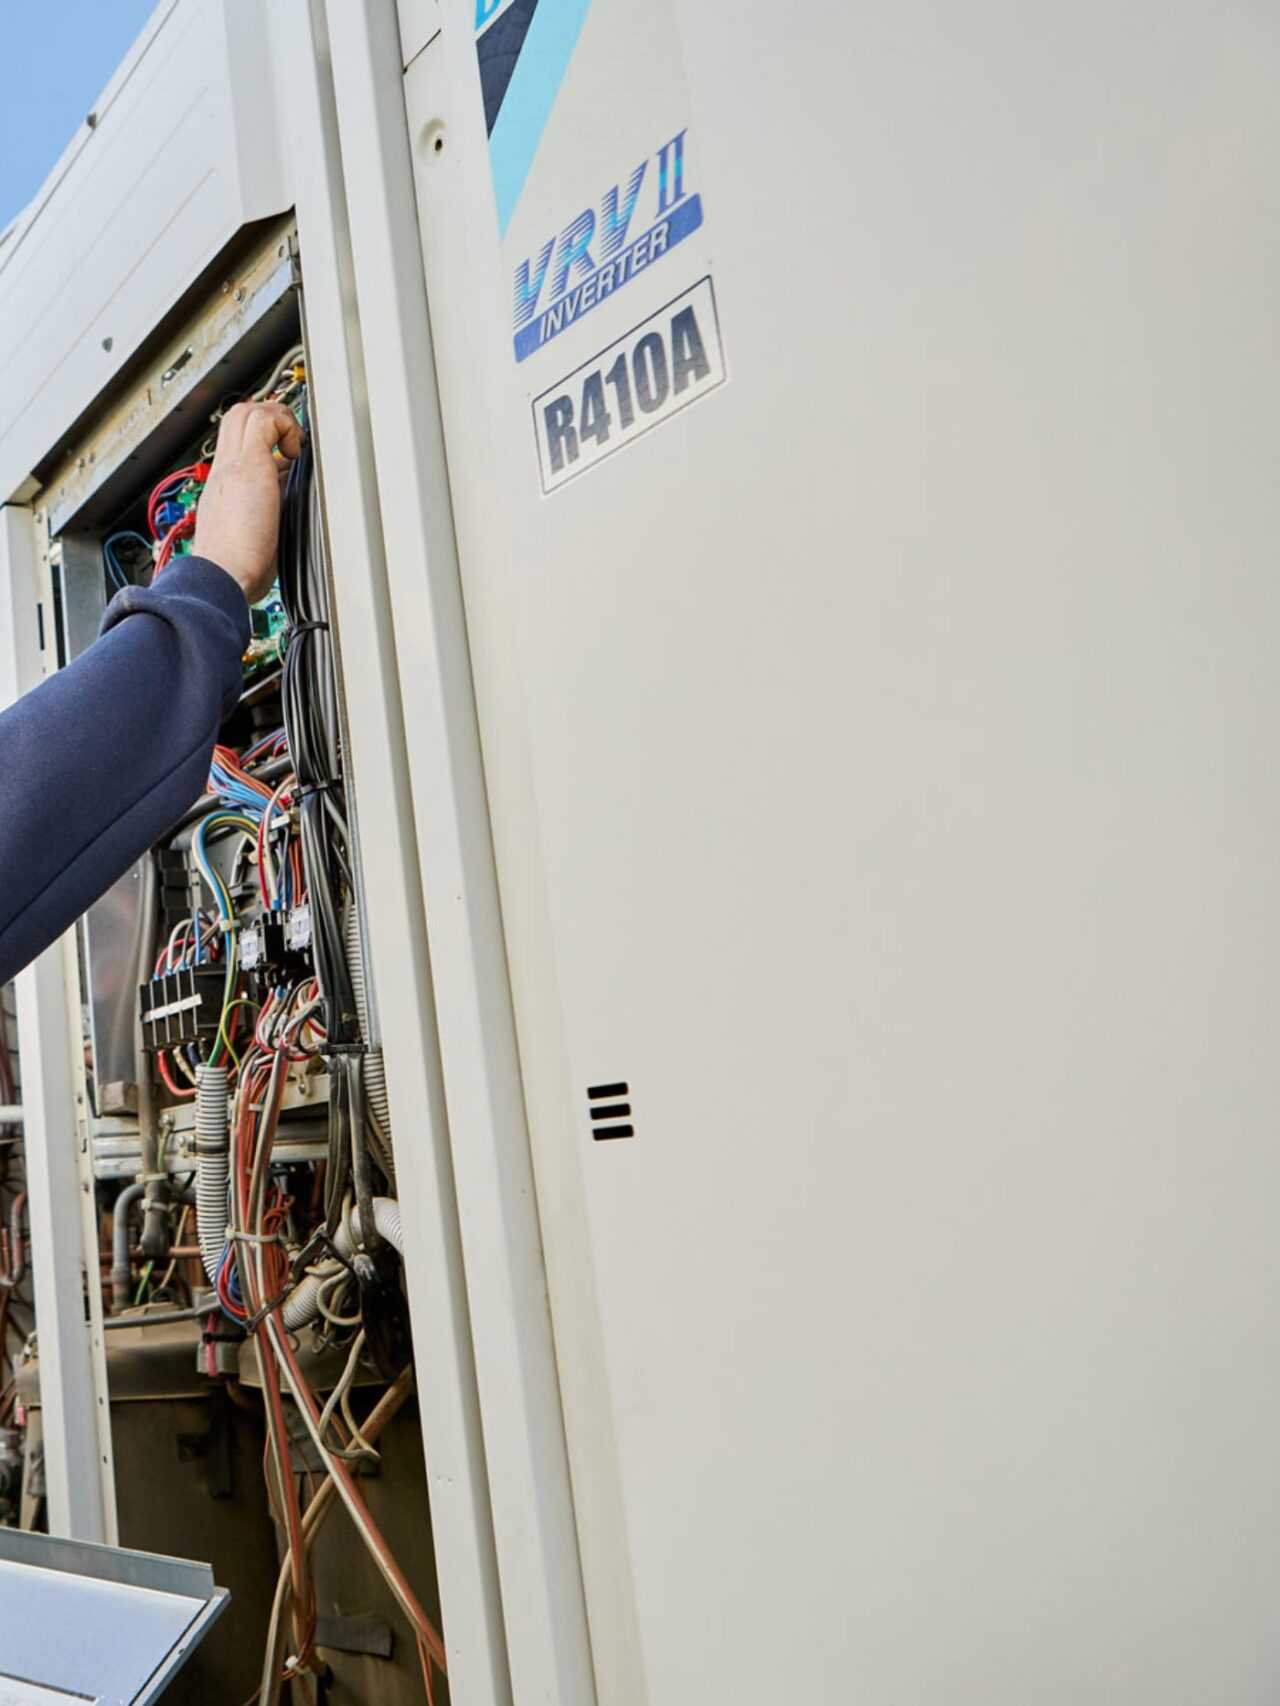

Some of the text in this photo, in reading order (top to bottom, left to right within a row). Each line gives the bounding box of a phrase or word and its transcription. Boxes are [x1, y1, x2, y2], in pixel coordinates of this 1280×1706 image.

[512, 159, 649, 330] VRV
[539, 221, 671, 344] INVERTER
[543, 304, 711, 475] R410A
